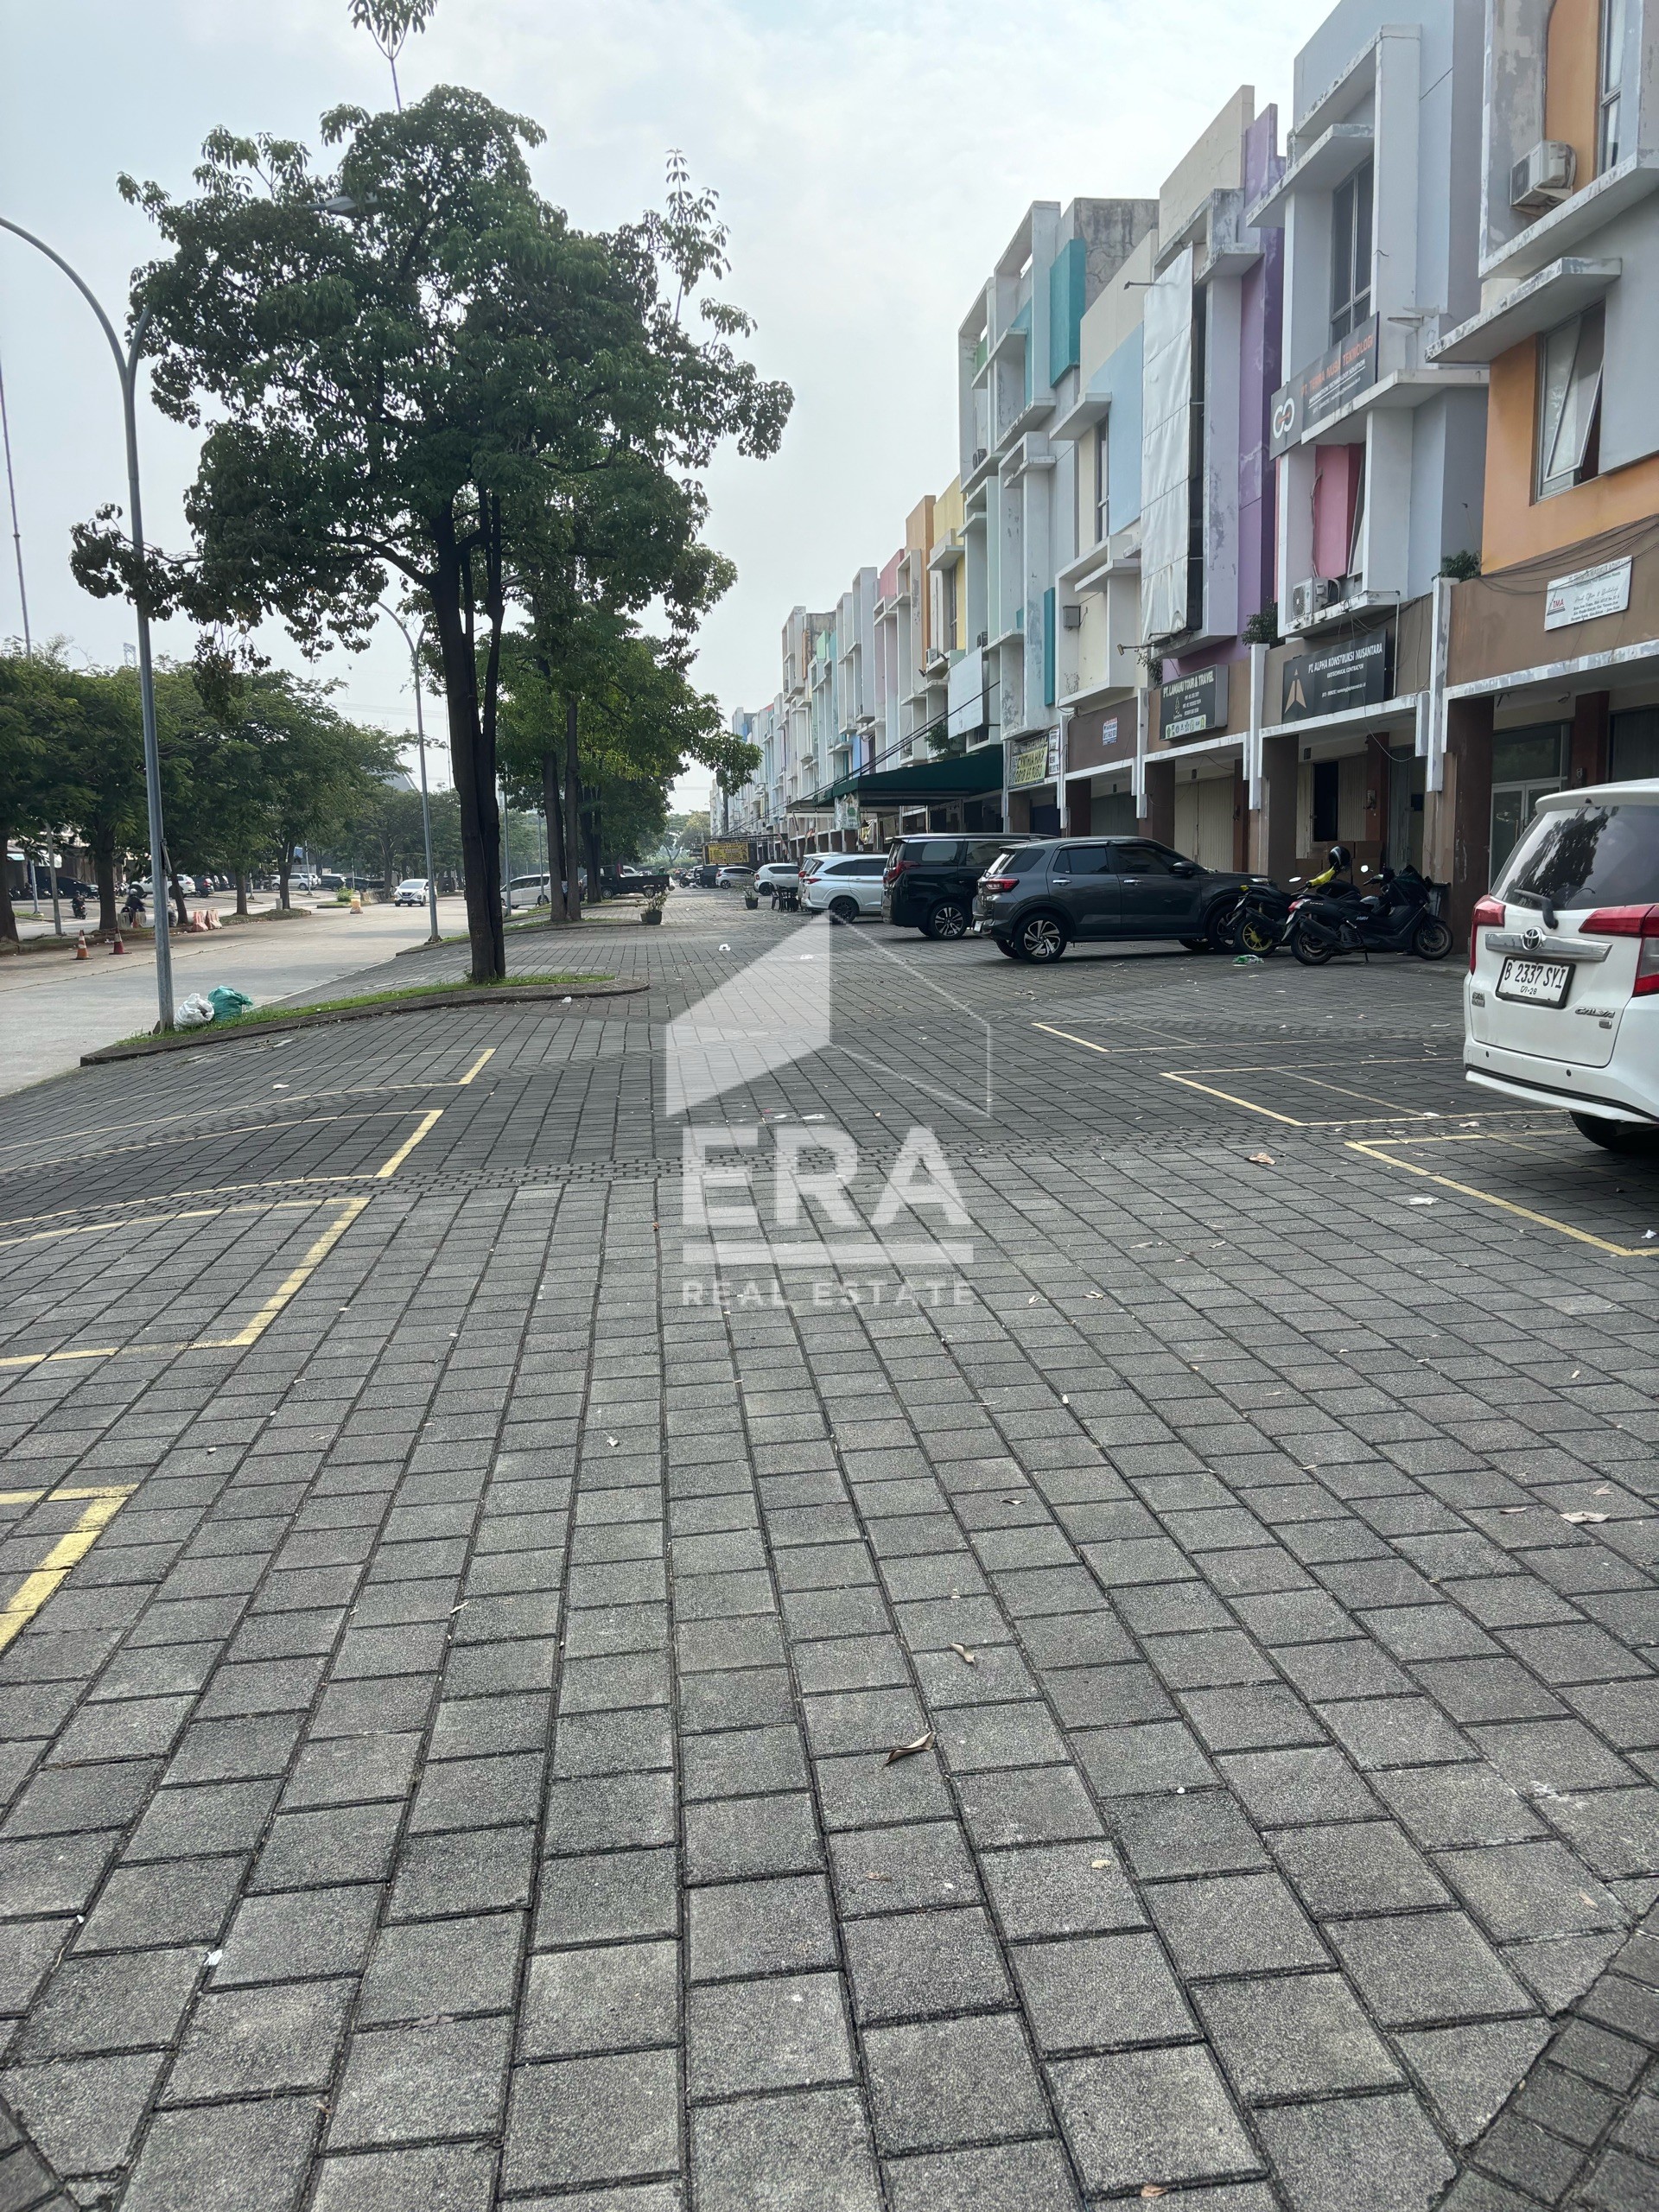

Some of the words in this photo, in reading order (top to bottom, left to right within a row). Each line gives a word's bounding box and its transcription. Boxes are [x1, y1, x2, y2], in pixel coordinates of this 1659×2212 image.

[1314, 659, 1328, 672] ALPHA
[1328, 650, 1355, 668] KONSTRUKSI
[1355, 642, 1382, 661] NUSANTARA
[1198, 671, 1214, 686] TRAVEL
[1504, 963, 1512, 980] B
[1515, 964, 1543, 985] 2337
[1542, 967, 1567, 989] SYI
